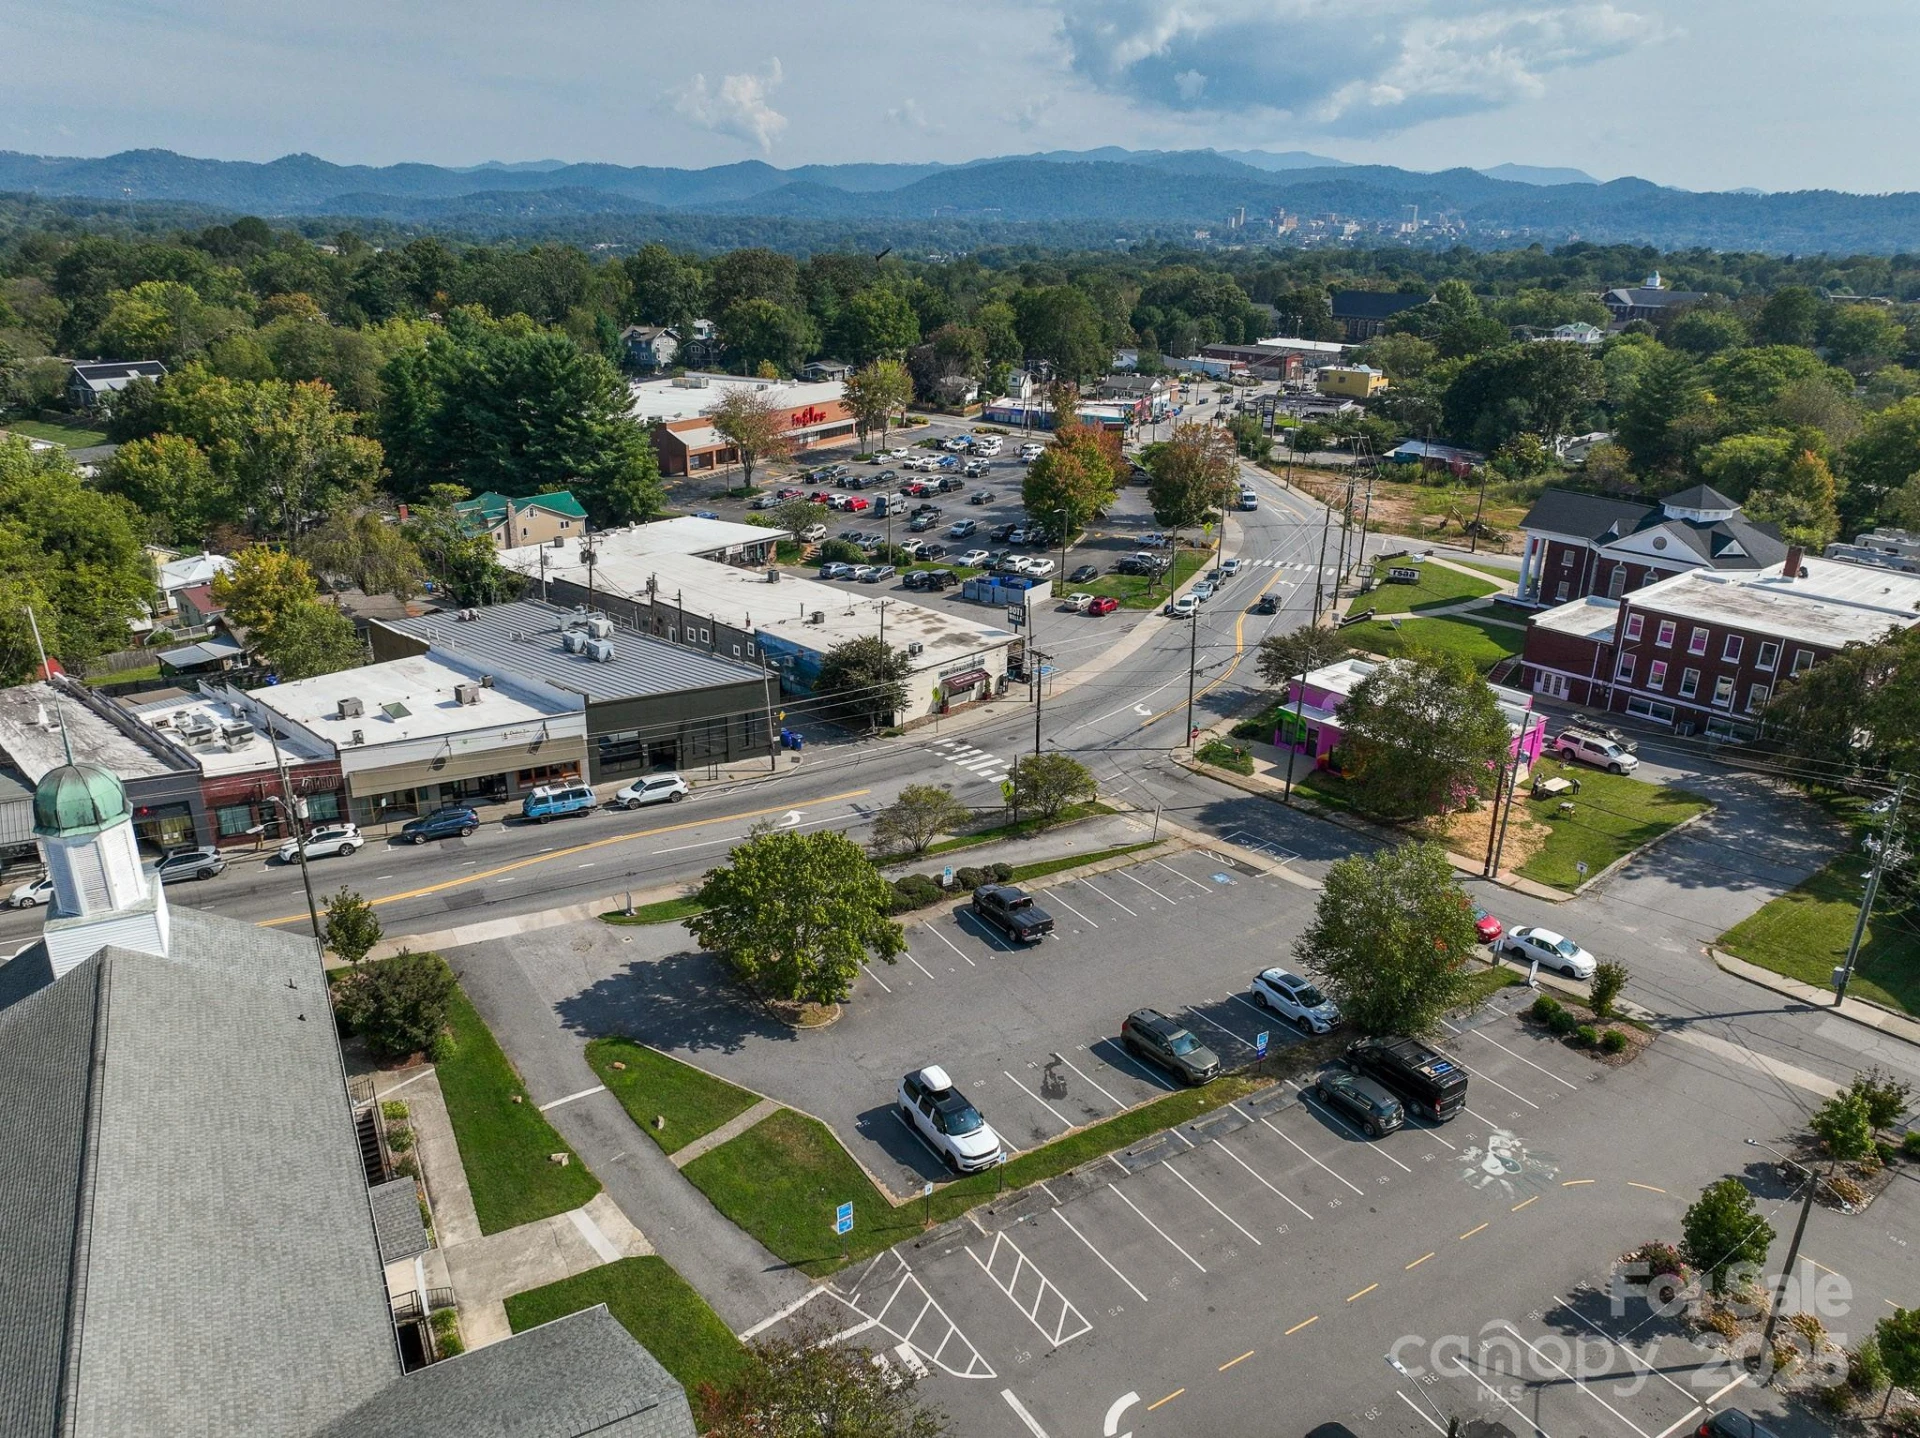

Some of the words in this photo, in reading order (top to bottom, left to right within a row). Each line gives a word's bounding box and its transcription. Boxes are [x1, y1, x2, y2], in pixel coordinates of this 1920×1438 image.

[1328, 1198, 1342, 1209] 28
[1276, 1224, 1290, 1234] 27
[1108, 1305, 1125, 1317] 24
[1015, 1351, 1032, 1364] 23
